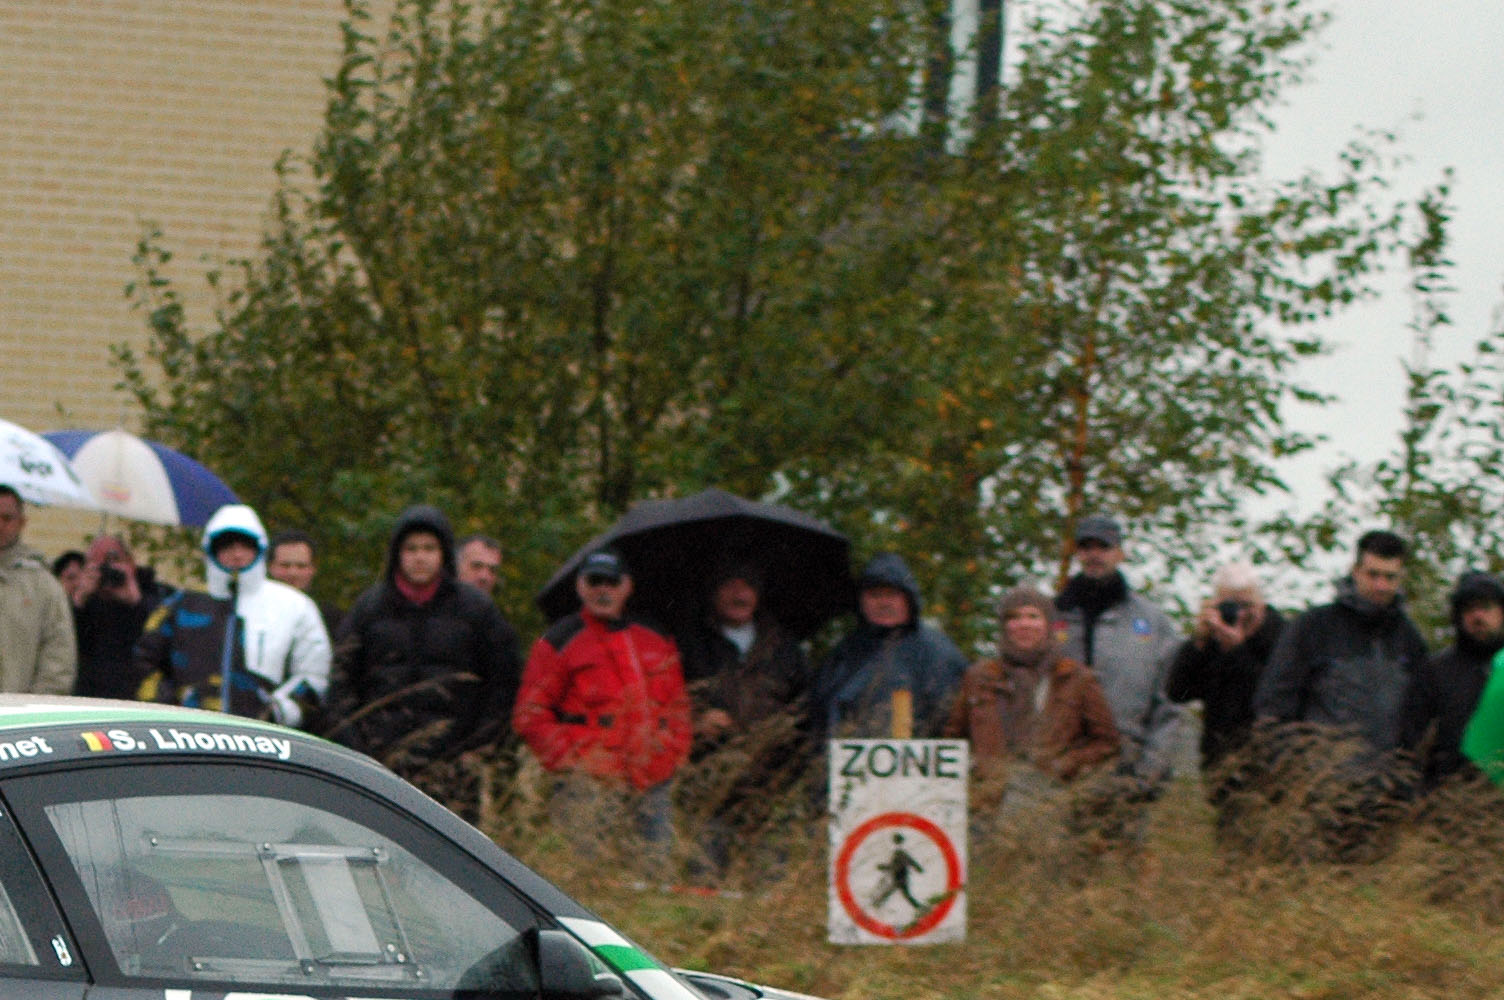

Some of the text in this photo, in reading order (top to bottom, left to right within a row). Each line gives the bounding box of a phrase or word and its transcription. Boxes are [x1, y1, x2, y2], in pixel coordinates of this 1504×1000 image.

[107, 728, 291, 760] S. Lhonnay
[841, 743, 960, 778] ZONE
